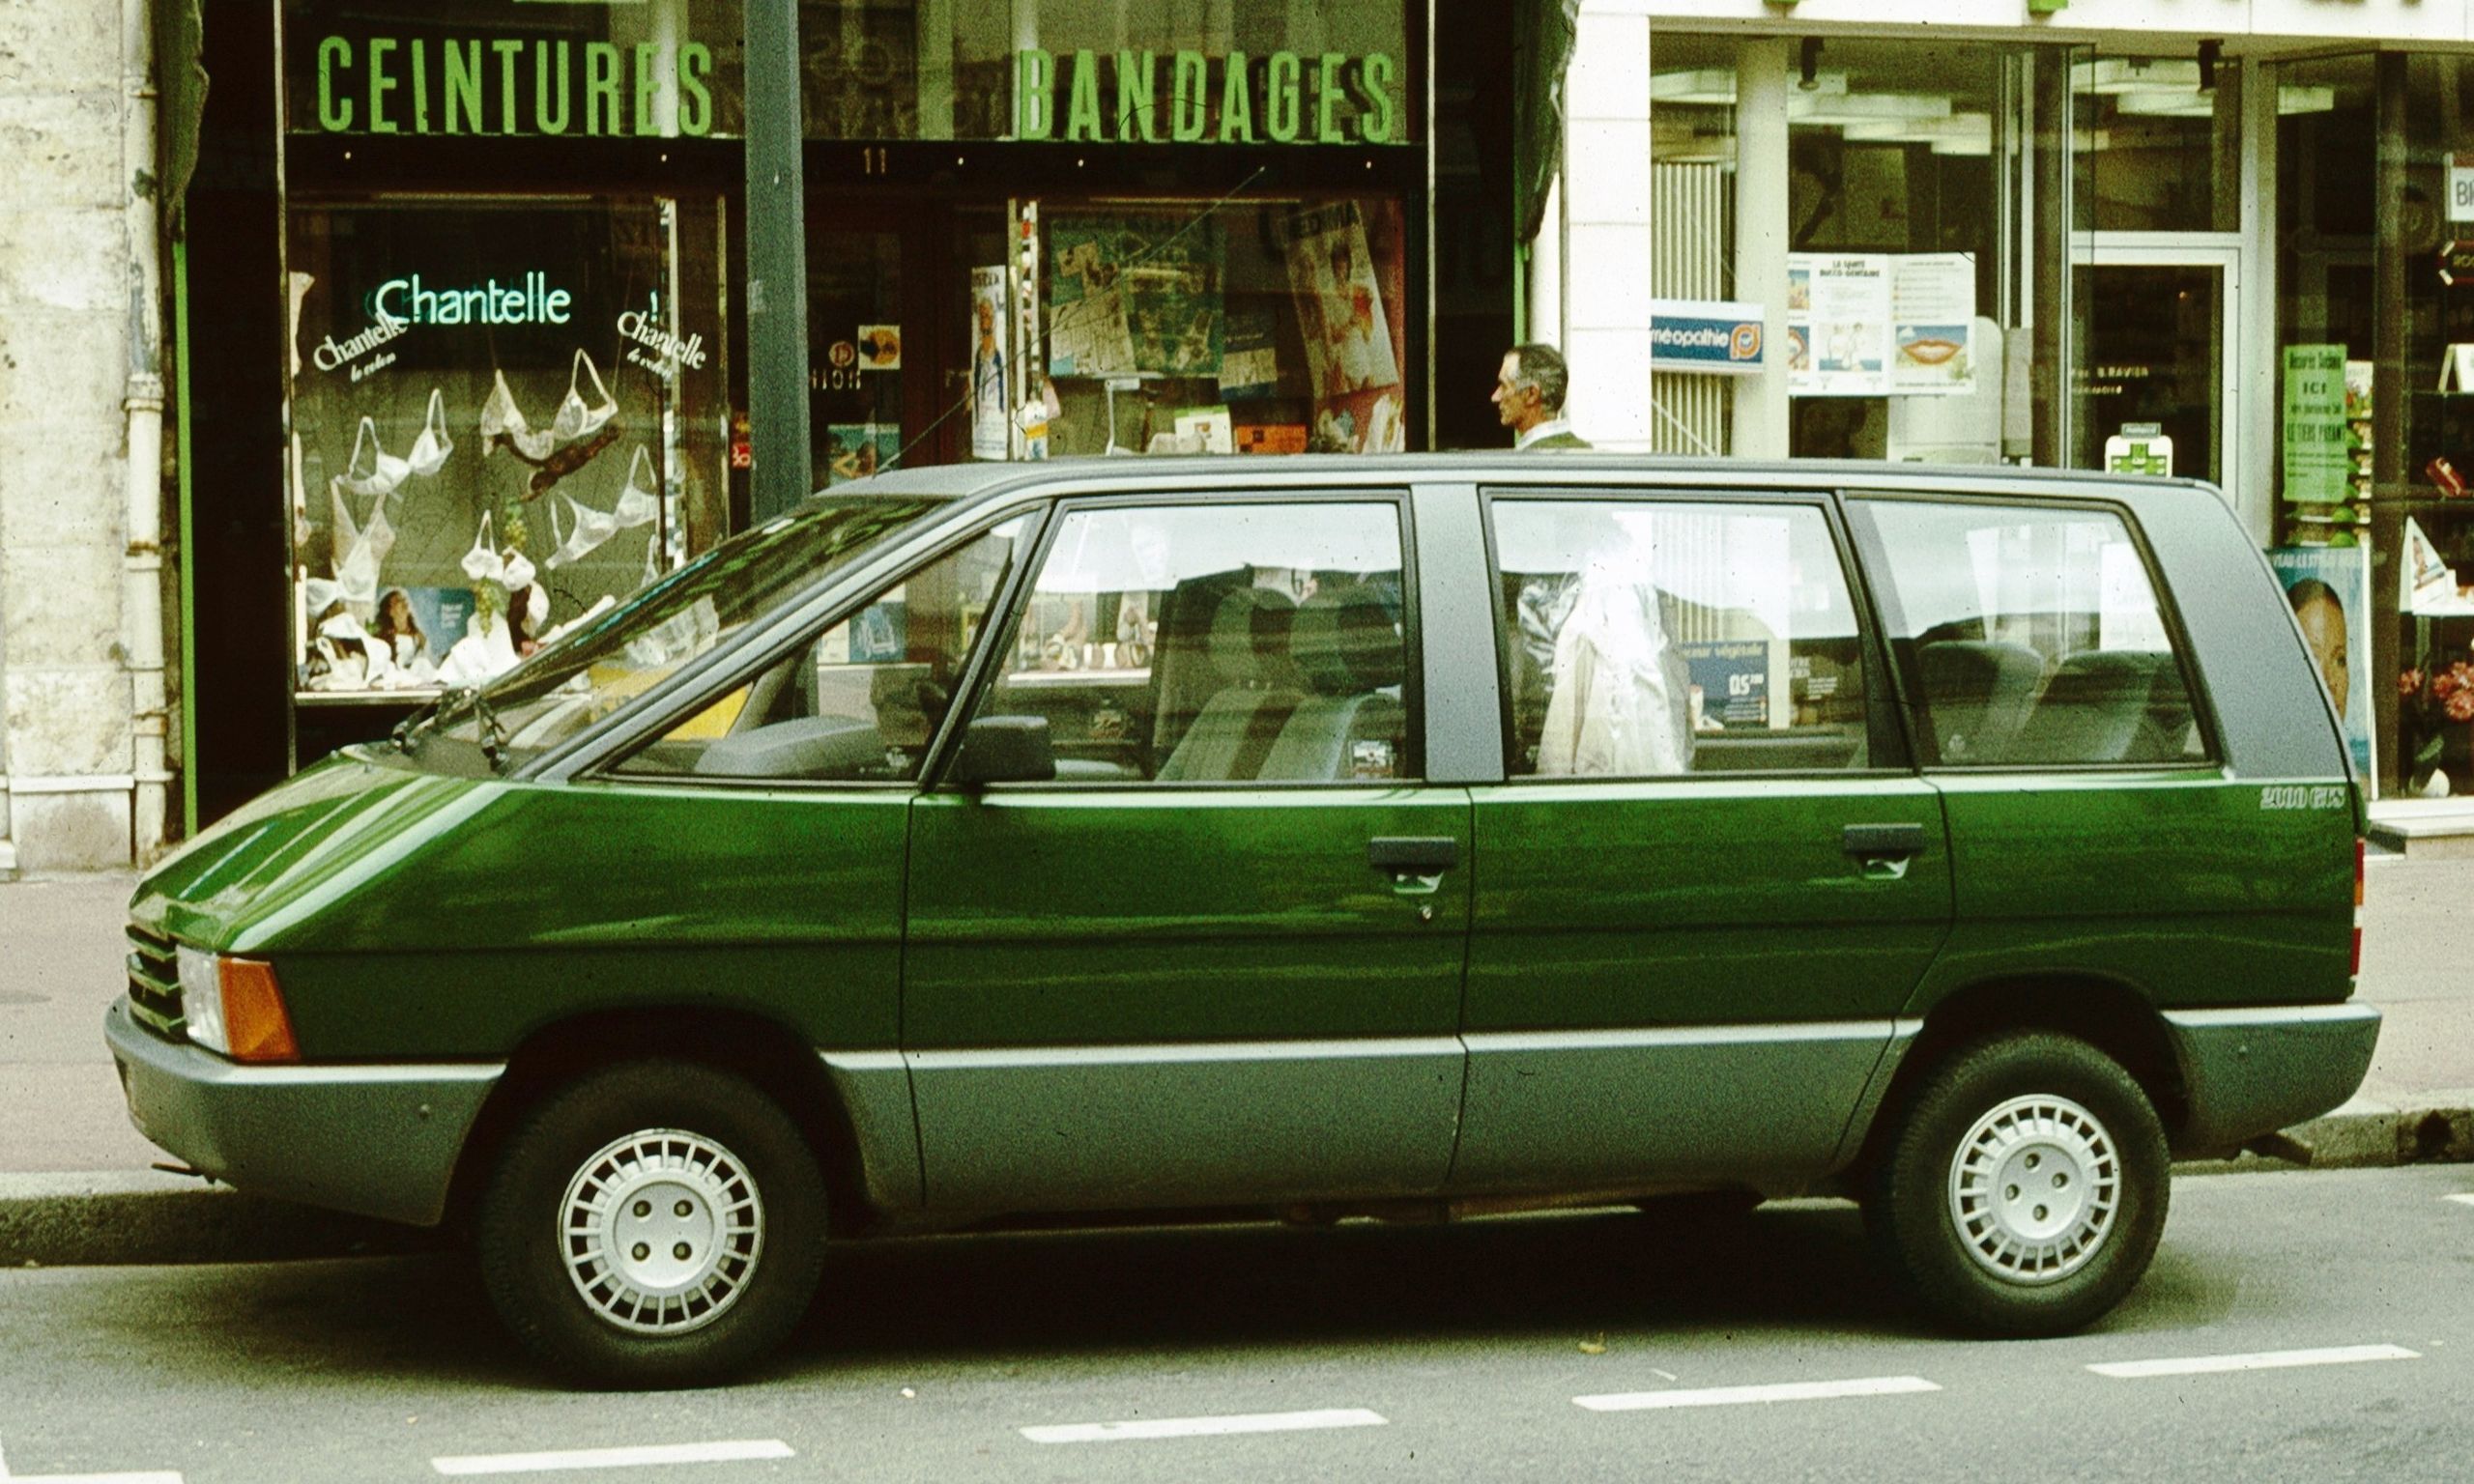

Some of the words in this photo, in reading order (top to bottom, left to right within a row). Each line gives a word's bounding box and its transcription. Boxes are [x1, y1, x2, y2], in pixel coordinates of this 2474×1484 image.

[317, 36, 712, 136] CEINTURES
[1018, 48, 1395, 143] BANDAGES
[375, 271, 571, 324] Chantelle
[313, 311, 409, 372] Chantelle
[617, 310, 706, 370] Chantelle
